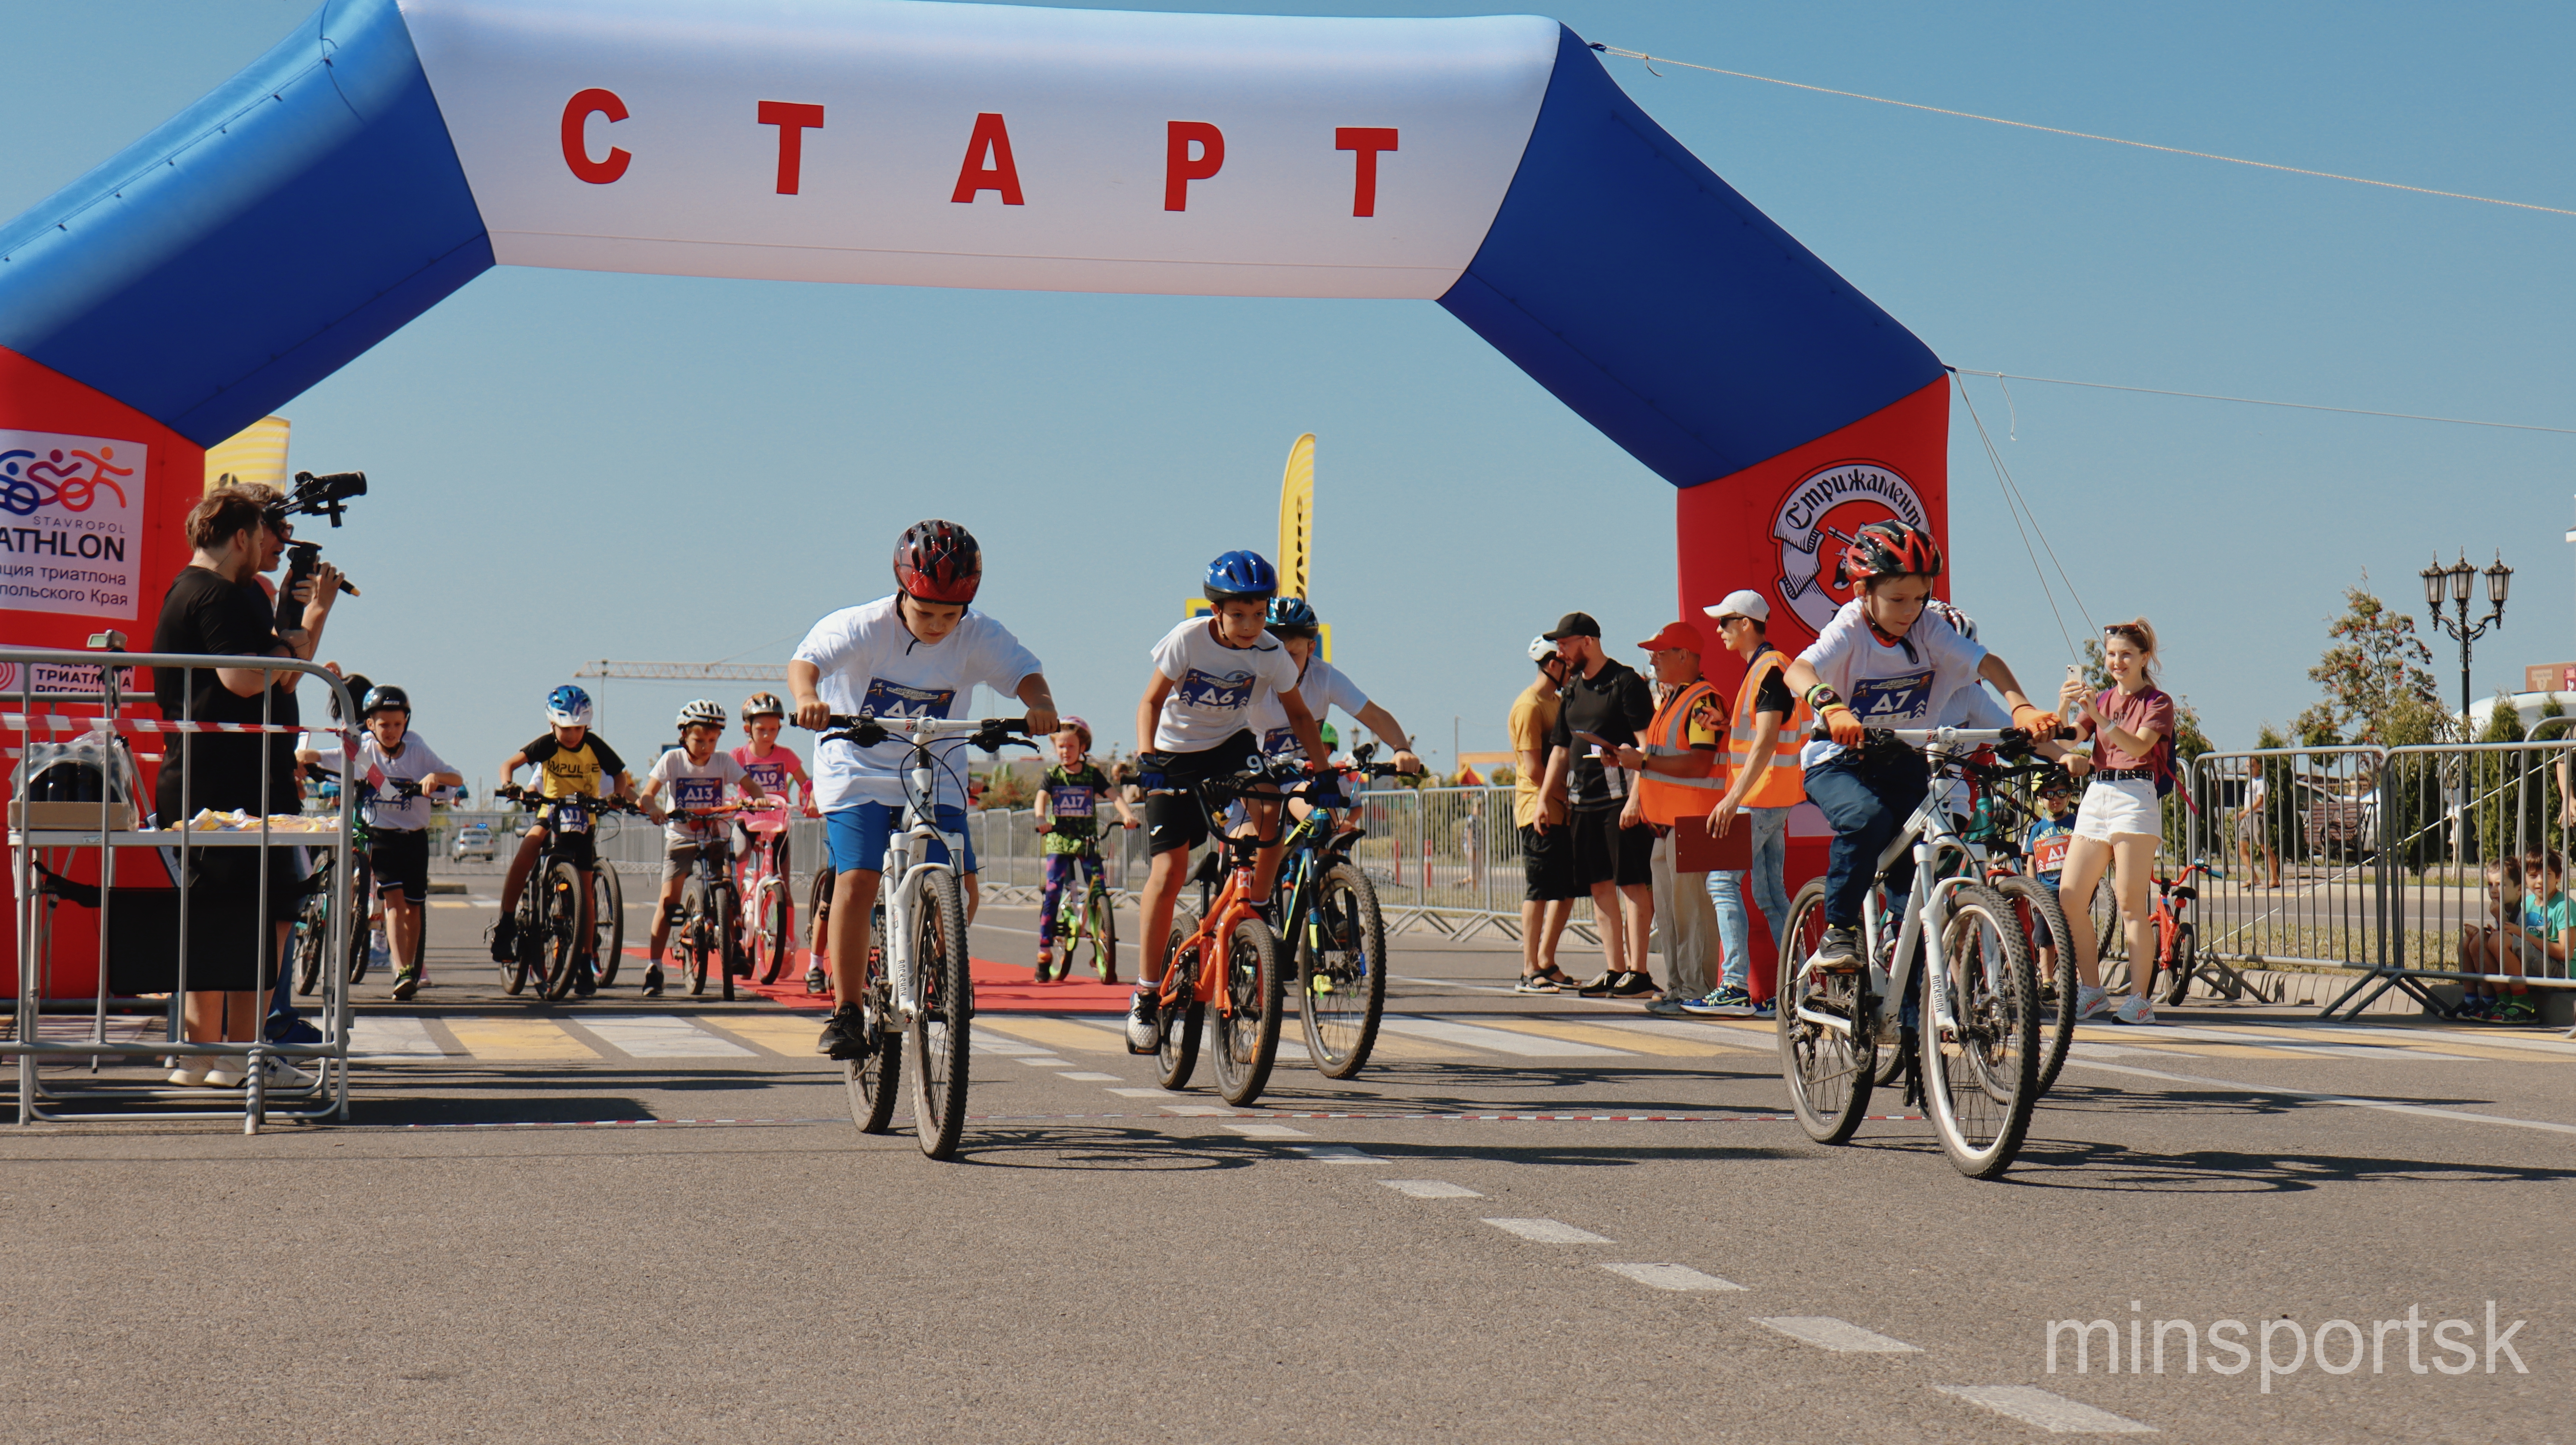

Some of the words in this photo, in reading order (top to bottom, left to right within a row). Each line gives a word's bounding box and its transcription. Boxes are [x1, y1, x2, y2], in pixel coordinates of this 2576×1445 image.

[561, 89, 1398, 218] СТАРТ
[285, 502, 305, 513] RONIN
[33, 515, 125, 534] STAVROPOL
[0, 564, 34, 577] ция
[40, 567, 126, 586] триатлона
[0, 584, 85, 601] польского
[90, 589, 128, 606] Края
[37, 668, 131, 688] ТРИАТЛА
[1198, 688, 1234, 705] Д6
[1870, 689, 1912, 713] Д7
[548, 760, 600, 774] IMPULSE
[684, 787, 714, 801] Д13
[1060, 795, 1085, 809] Д17
